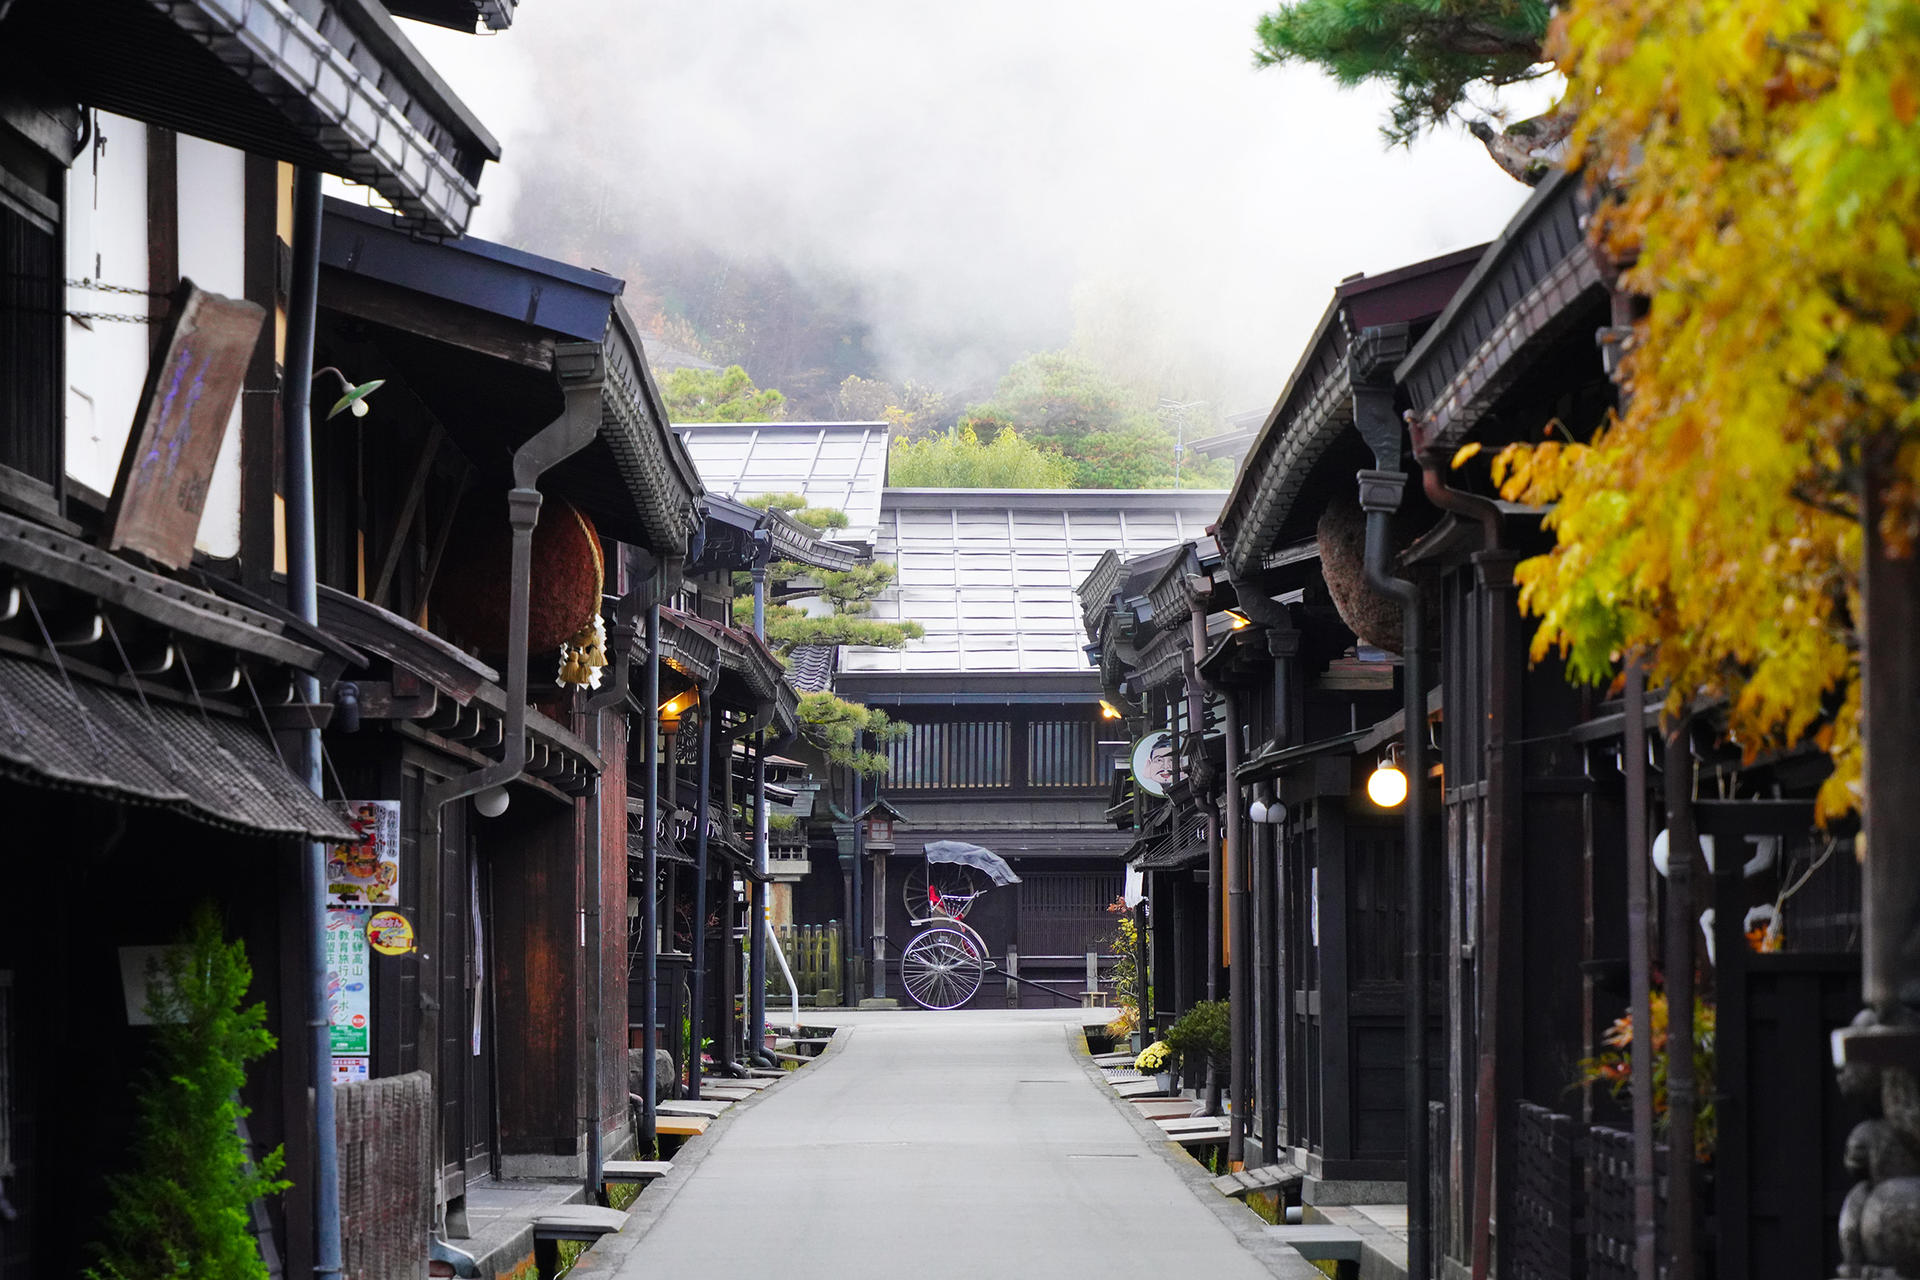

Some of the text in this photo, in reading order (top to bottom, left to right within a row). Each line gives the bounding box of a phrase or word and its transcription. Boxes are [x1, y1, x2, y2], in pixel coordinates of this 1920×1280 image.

[338, 930, 350, 1022] 教育旅行クーポン
[351, 930, 364, 976] 飛騨高山
